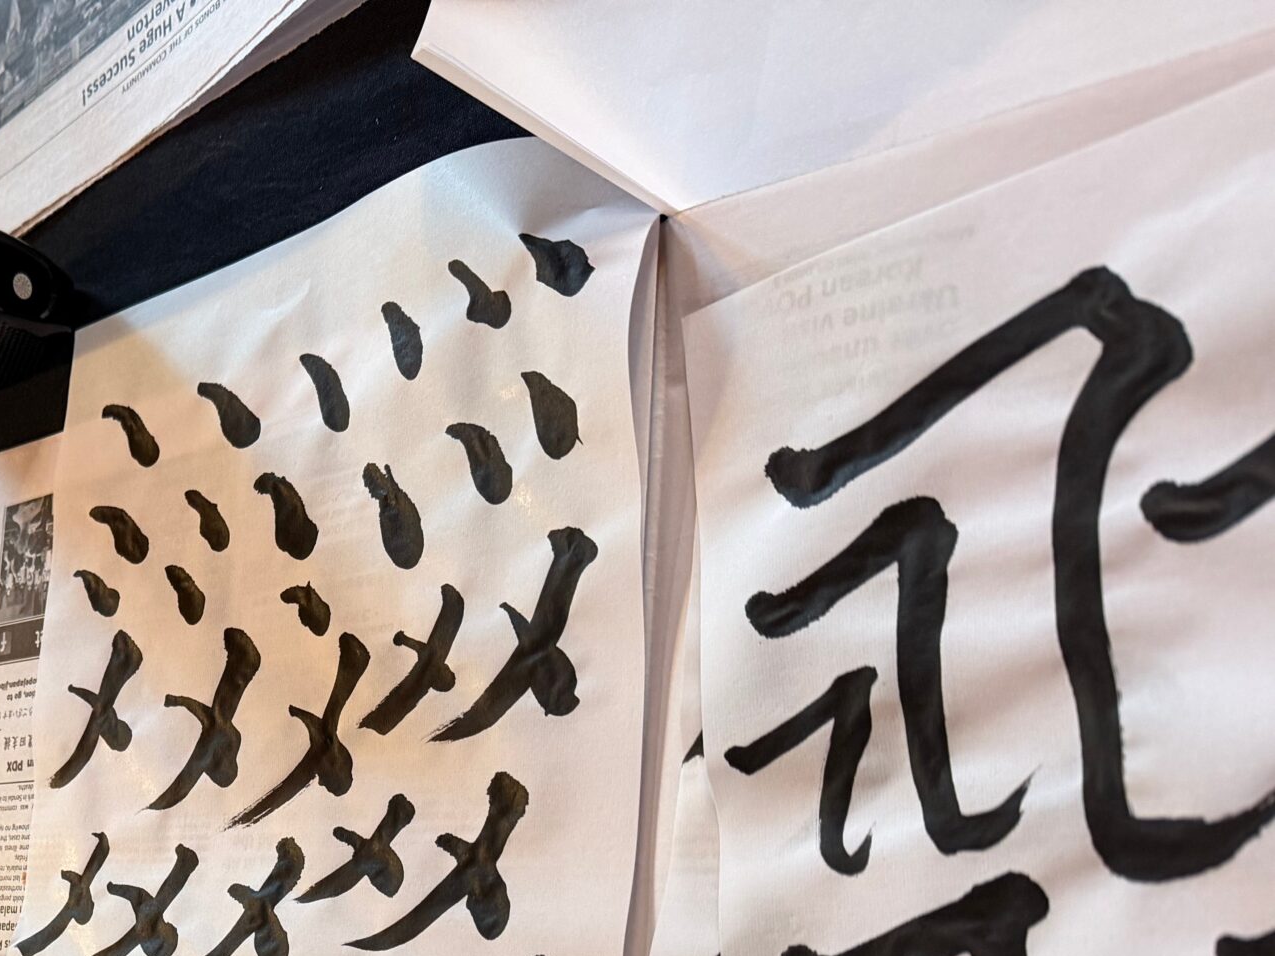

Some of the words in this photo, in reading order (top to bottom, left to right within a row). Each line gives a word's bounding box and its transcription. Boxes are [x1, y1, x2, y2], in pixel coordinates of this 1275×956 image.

[176, 2, 186, 22] A
[138, 16, 173, 53] Huge
[81, 47, 136, 107] Success!
[120, 49, 167, 95] COMMUNITY
[6, 760, 24, 773] PDX
